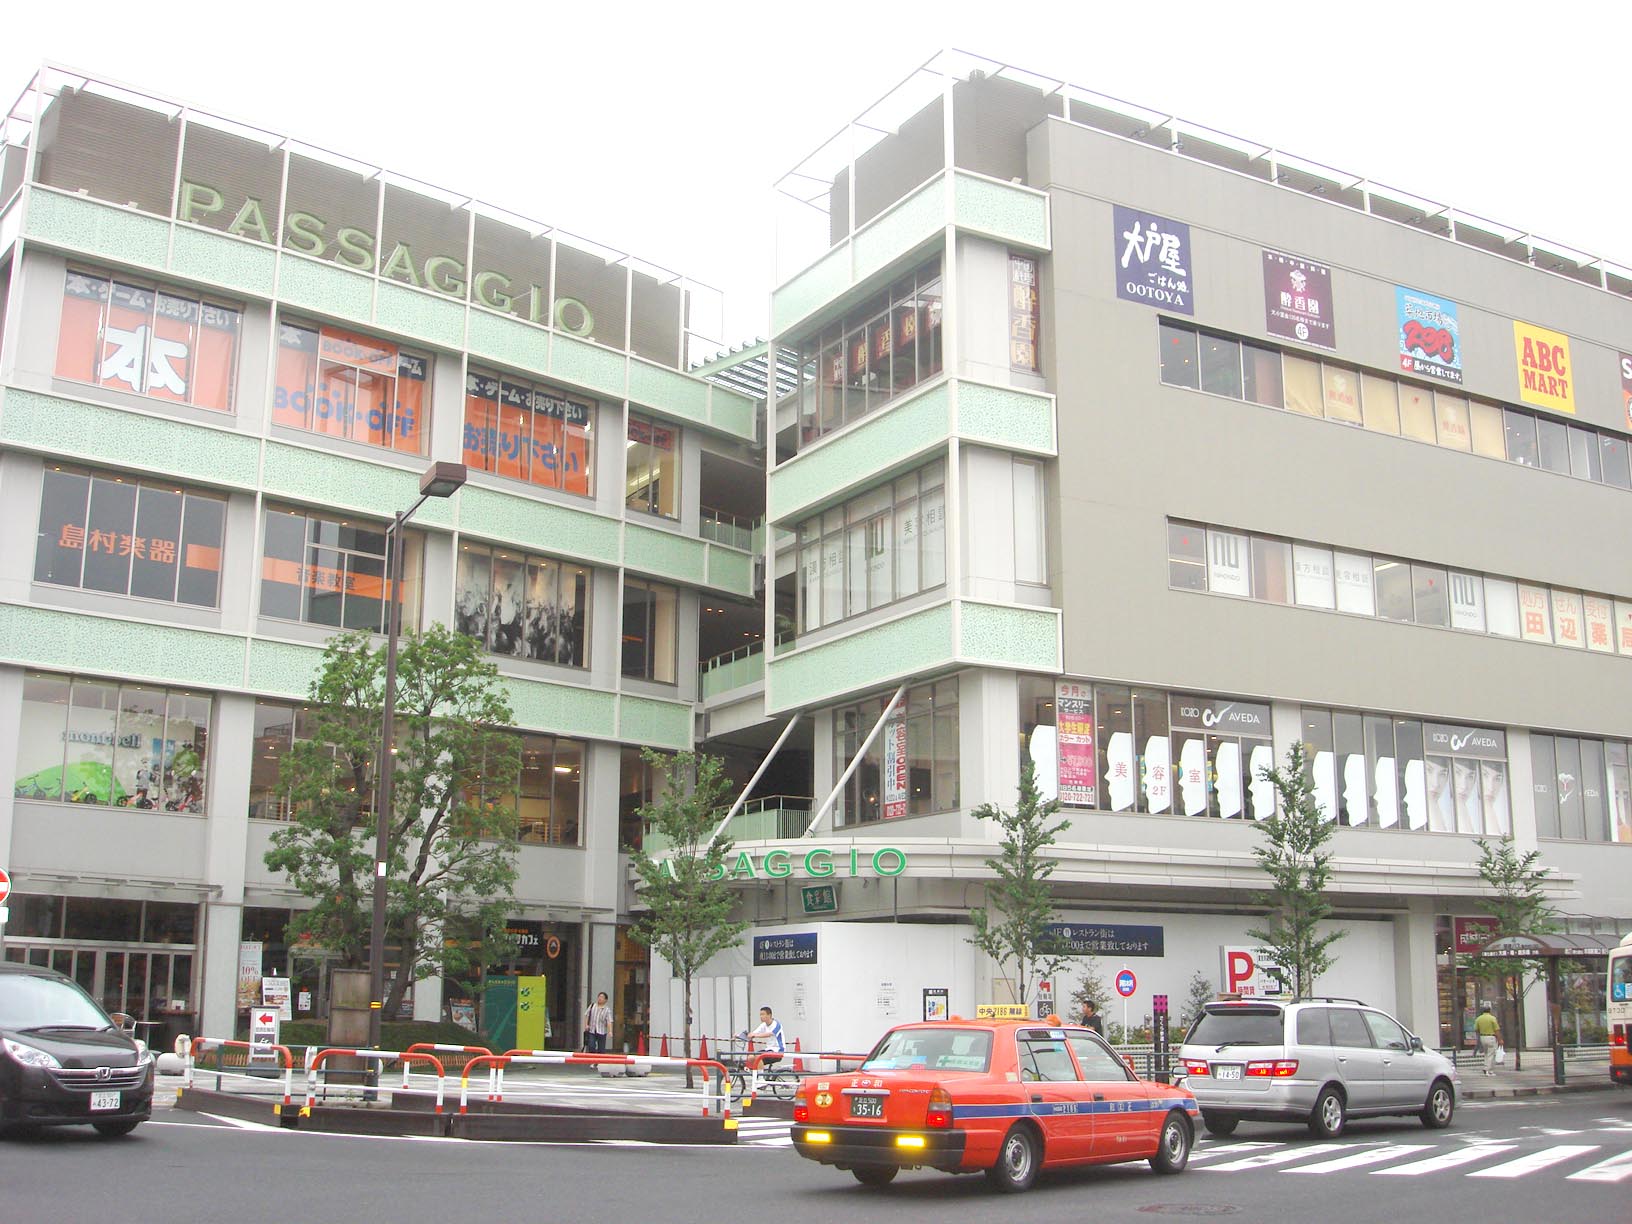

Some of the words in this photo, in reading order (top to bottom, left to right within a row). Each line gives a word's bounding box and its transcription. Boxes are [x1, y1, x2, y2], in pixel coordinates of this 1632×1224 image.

[180, 181, 594, 338] PASSAGGIO
[1121, 221, 1186, 277] 大戸屋
[1126, 281, 1184, 306] OOTOYA
[98, 324, 189, 395] 本
[1522, 336, 1566, 377] ABC
[1523, 369, 1568, 400] MART
[464, 421, 580, 473] お売り下さい
[1522, 590, 1607, 619] 処方せん受付
[1228, 712, 1260, 724] AVEDA
[1471, 737, 1498, 748] AVEDA
[1152, 785, 1167, 796] 2F
[1072, 928, 1115, 938] レストラン街は
[1228, 952, 1254, 993] P
[979, 1008, 992, 1016] 中央
[856, 1104, 882, 1116] 35-16
